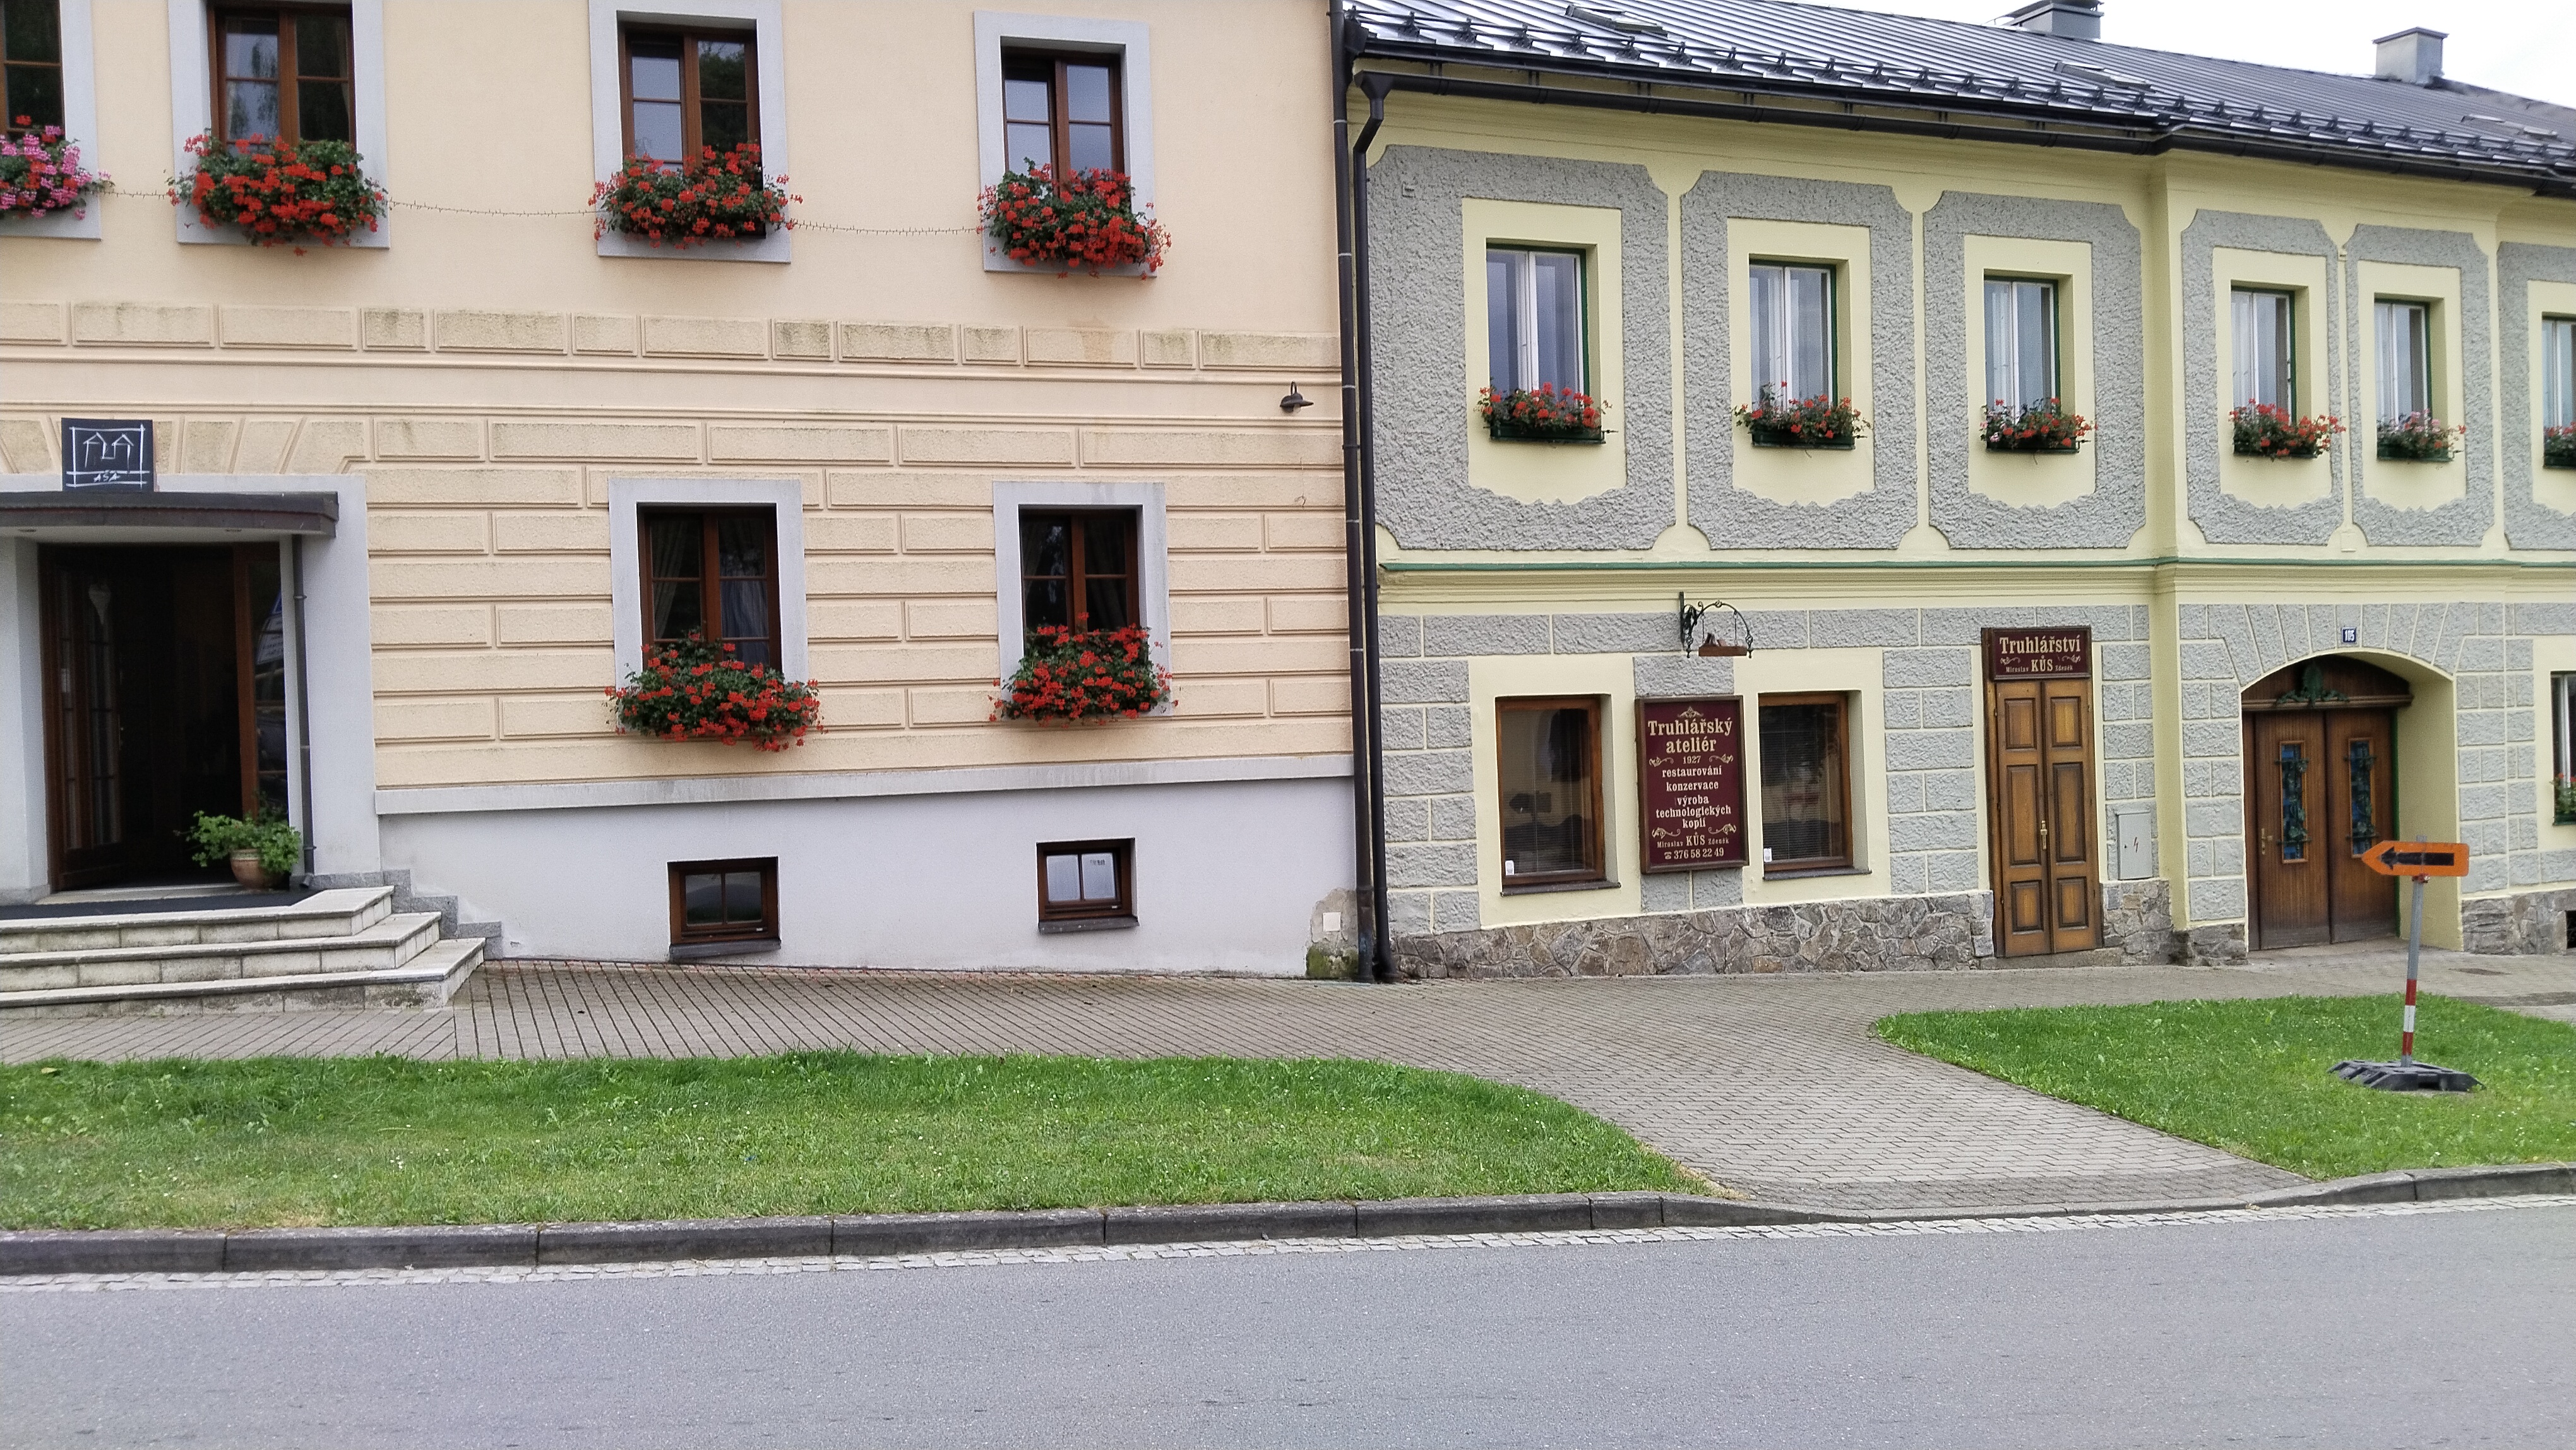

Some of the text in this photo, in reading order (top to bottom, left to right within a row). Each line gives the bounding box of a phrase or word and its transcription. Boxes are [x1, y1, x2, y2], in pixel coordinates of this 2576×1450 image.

[1999, 635, 2081, 654] Truhlářství
[2030, 655, 2053, 672] KŮS
[1647, 717, 1732, 736] Truhlářský
[1666, 736, 1717, 754] ateliér
[1683, 756, 1701, 764] 1927
[1662, 765, 1722, 777] restaurování
[1666, 781, 1719, 791] konzervace
[1677, 795, 1709, 807] výroba
[1655, 805, 1731, 818] technologických
[1686, 832, 1705, 846] KŮS
[1674, 849, 1689, 860] 376
[1690, 848, 1701, 858] 58
[1702, 848, 1713, 858] 22
